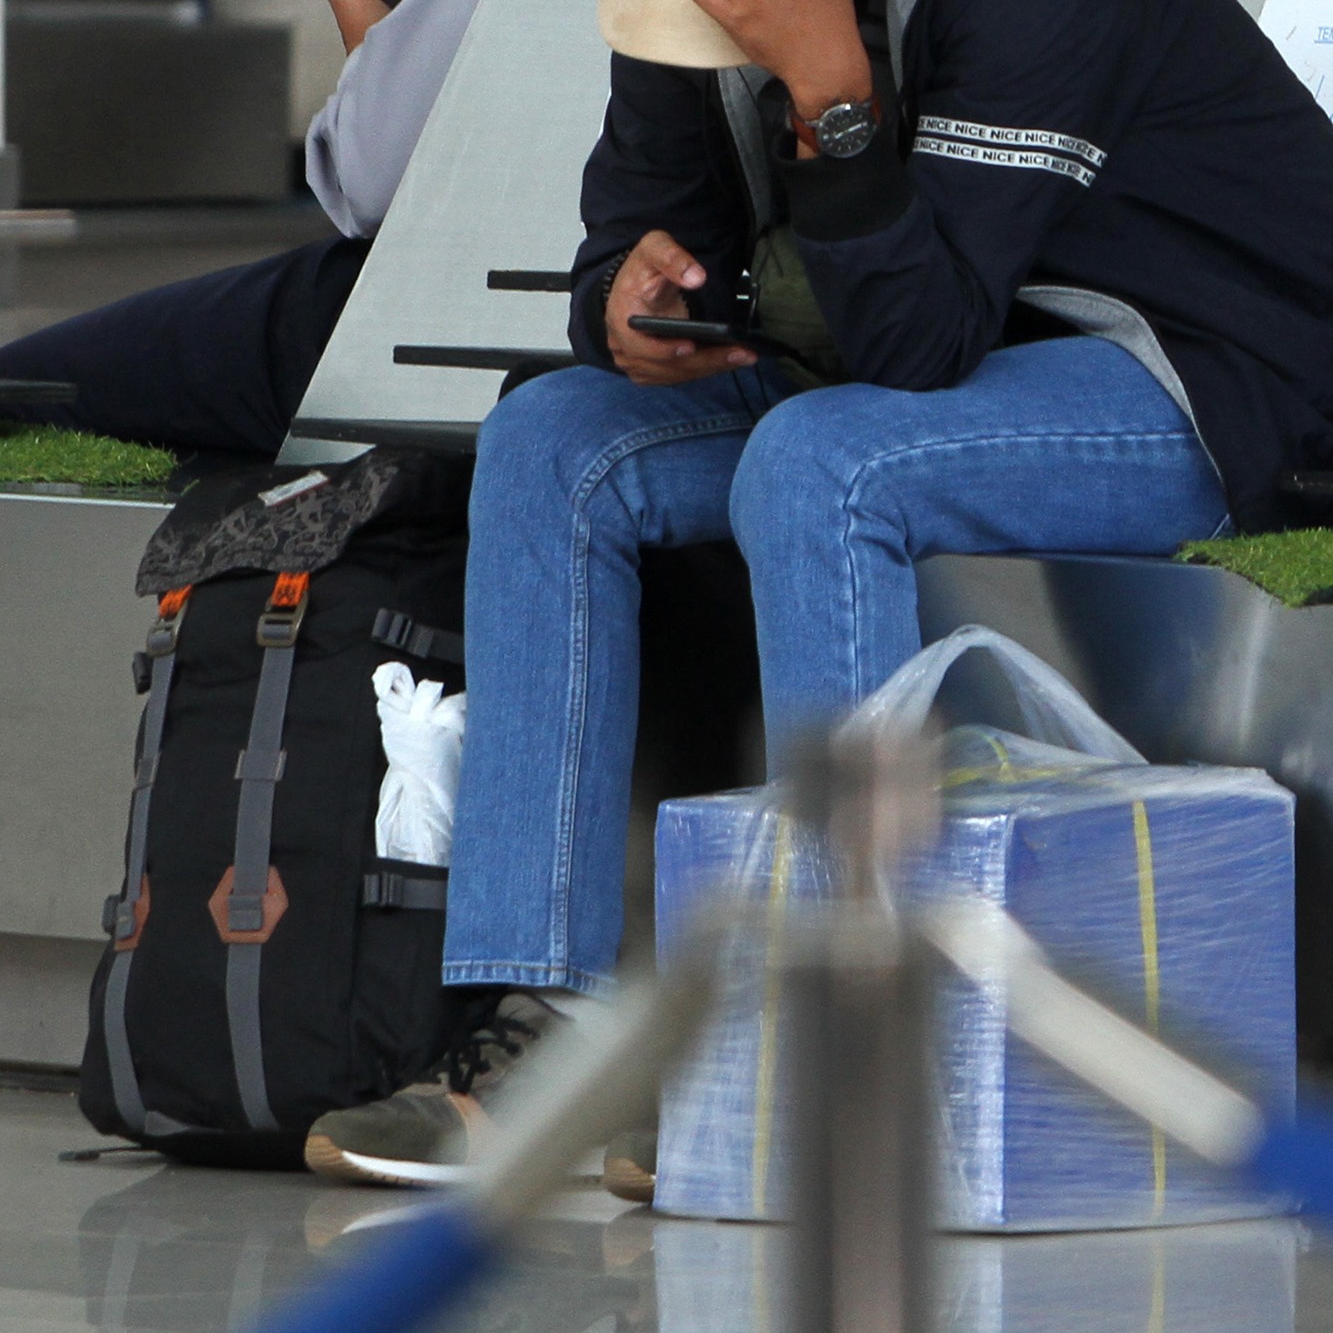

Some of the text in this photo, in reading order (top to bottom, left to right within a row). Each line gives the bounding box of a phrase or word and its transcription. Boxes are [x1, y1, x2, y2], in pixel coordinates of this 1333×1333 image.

[955, 123, 987, 138] NICE
[990, 129, 1022, 142] NICE
[1025, 132, 1056, 144] NICE
[947, 144, 980, 158] NICE
[982, 150, 1015, 163] NICE
[1019, 154, 1050, 166] NICE
